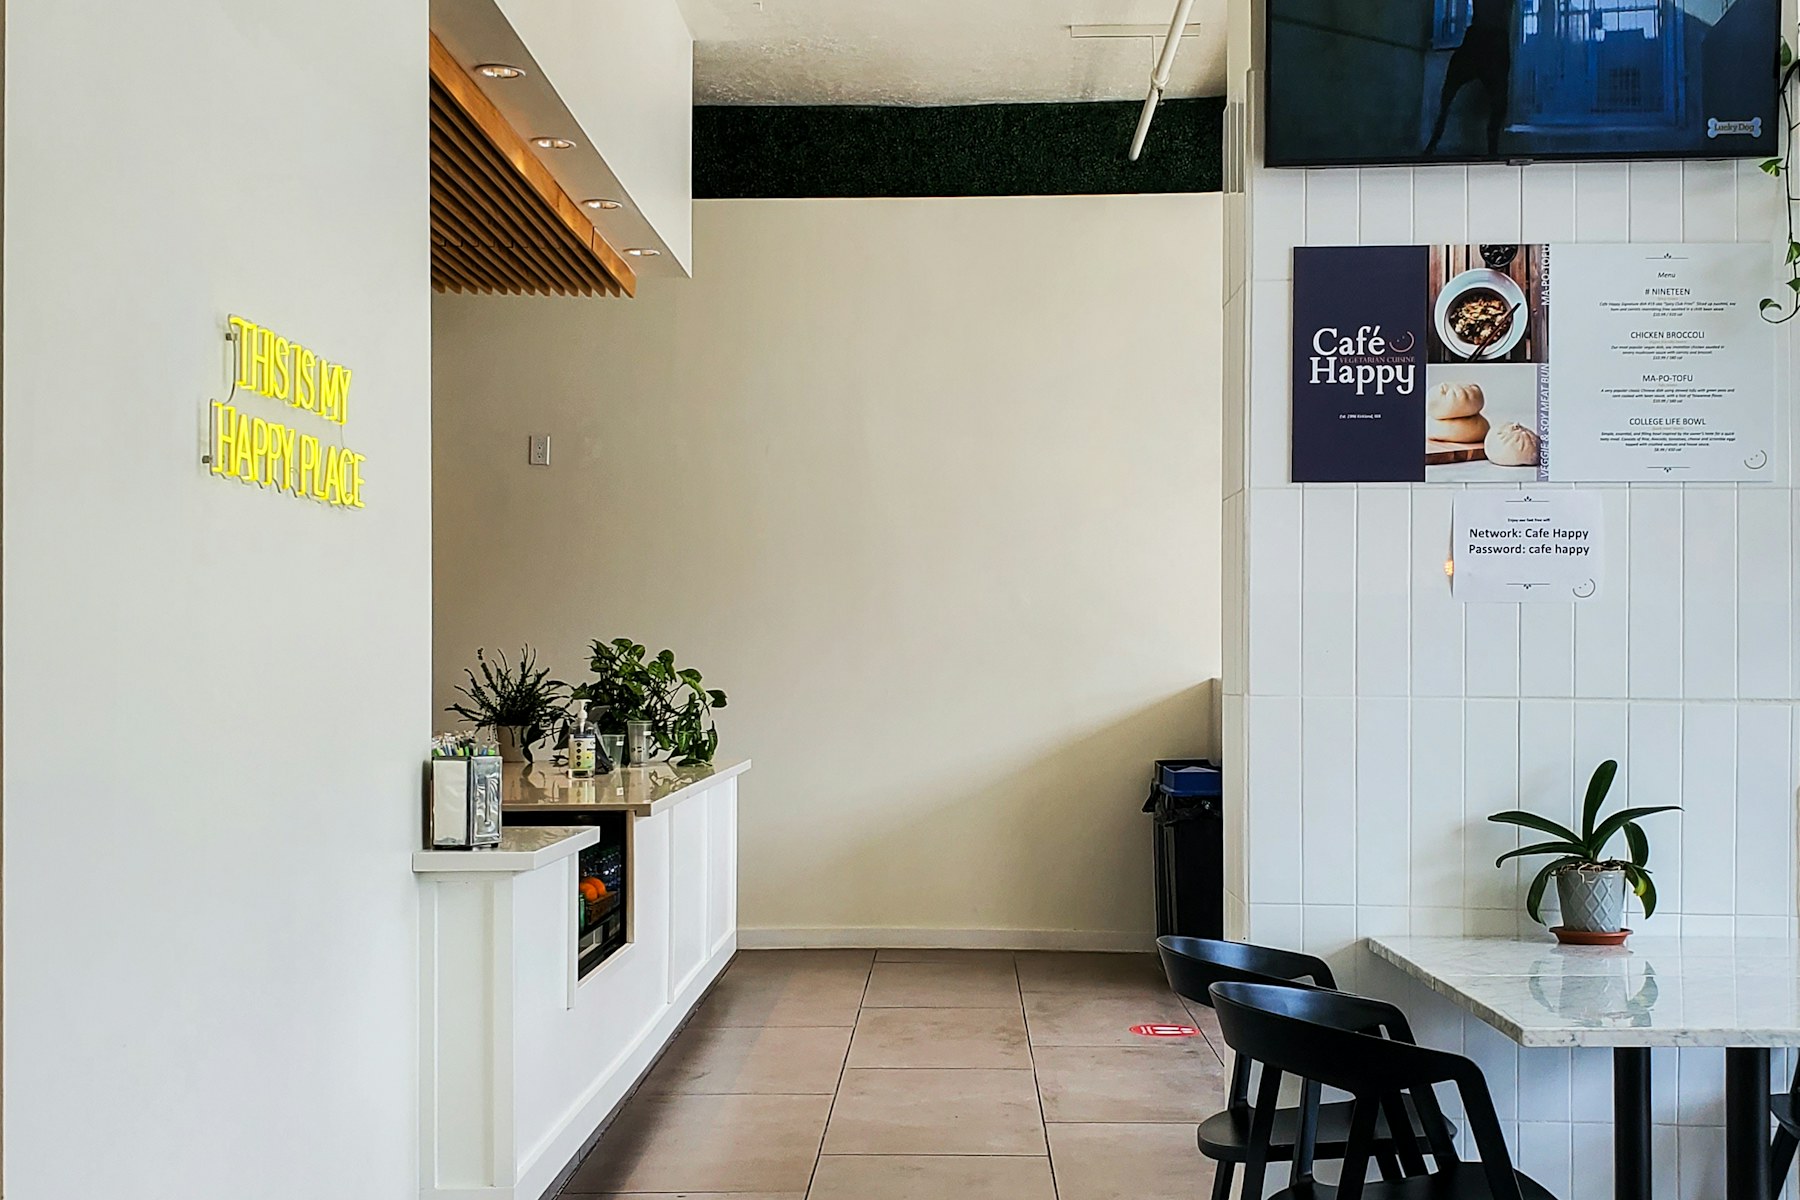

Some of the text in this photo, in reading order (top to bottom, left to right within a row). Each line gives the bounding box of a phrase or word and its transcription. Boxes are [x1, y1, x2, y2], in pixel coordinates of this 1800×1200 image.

[1714, 123, 1755, 132] Lucky Dog
[1541, 245, 1550, 306] MA-PO-TOFU
[1657, 271, 1676, 279] Menu
[1651, 288, 1691, 296] NINETEEN
[1312, 325, 1385, 356] Café
[1630, 331, 1705, 339] CHICKEN BROCCOLI
[229, 316, 352, 425] THIS IS MY
[1309, 357, 1416, 395] Happy
[1541, 363, 1549, 384] BUN
[1541, 385, 1549, 412] MEAT
[1541, 413, 1549, 432] SOY
[1629, 418, 1707, 426] COLLEGE LIFE BOWL
[211, 402, 366, 508] HAPPY PLACE
[1541, 444, 1549, 478] VEGGIE
[1469, 528, 1589, 540] Network: Cafe Happy
[1469, 544, 1590, 556] Password: cafe happy
